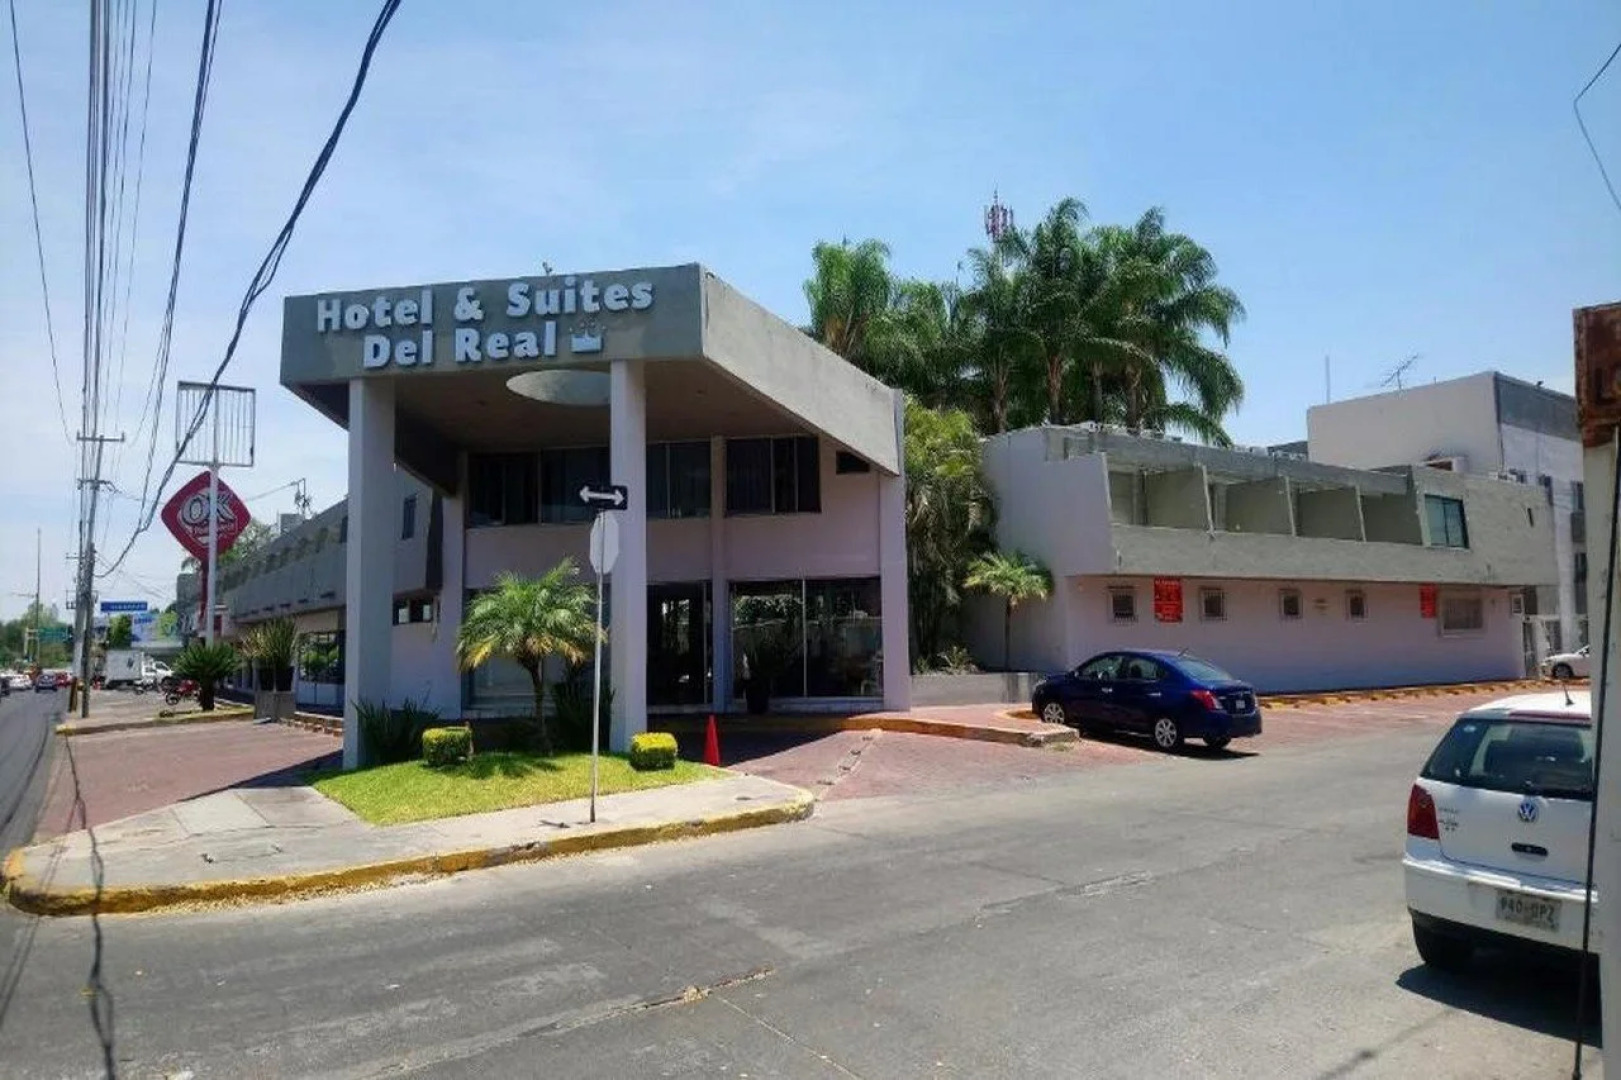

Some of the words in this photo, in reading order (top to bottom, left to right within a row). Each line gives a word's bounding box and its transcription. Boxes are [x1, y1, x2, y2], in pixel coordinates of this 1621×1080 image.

[317, 286, 434, 333] Hotel
[453, 287, 485, 321] &
[506, 276, 654, 319] Suites
[363, 329, 434, 369] Del
[454, 321, 557, 362] Real
